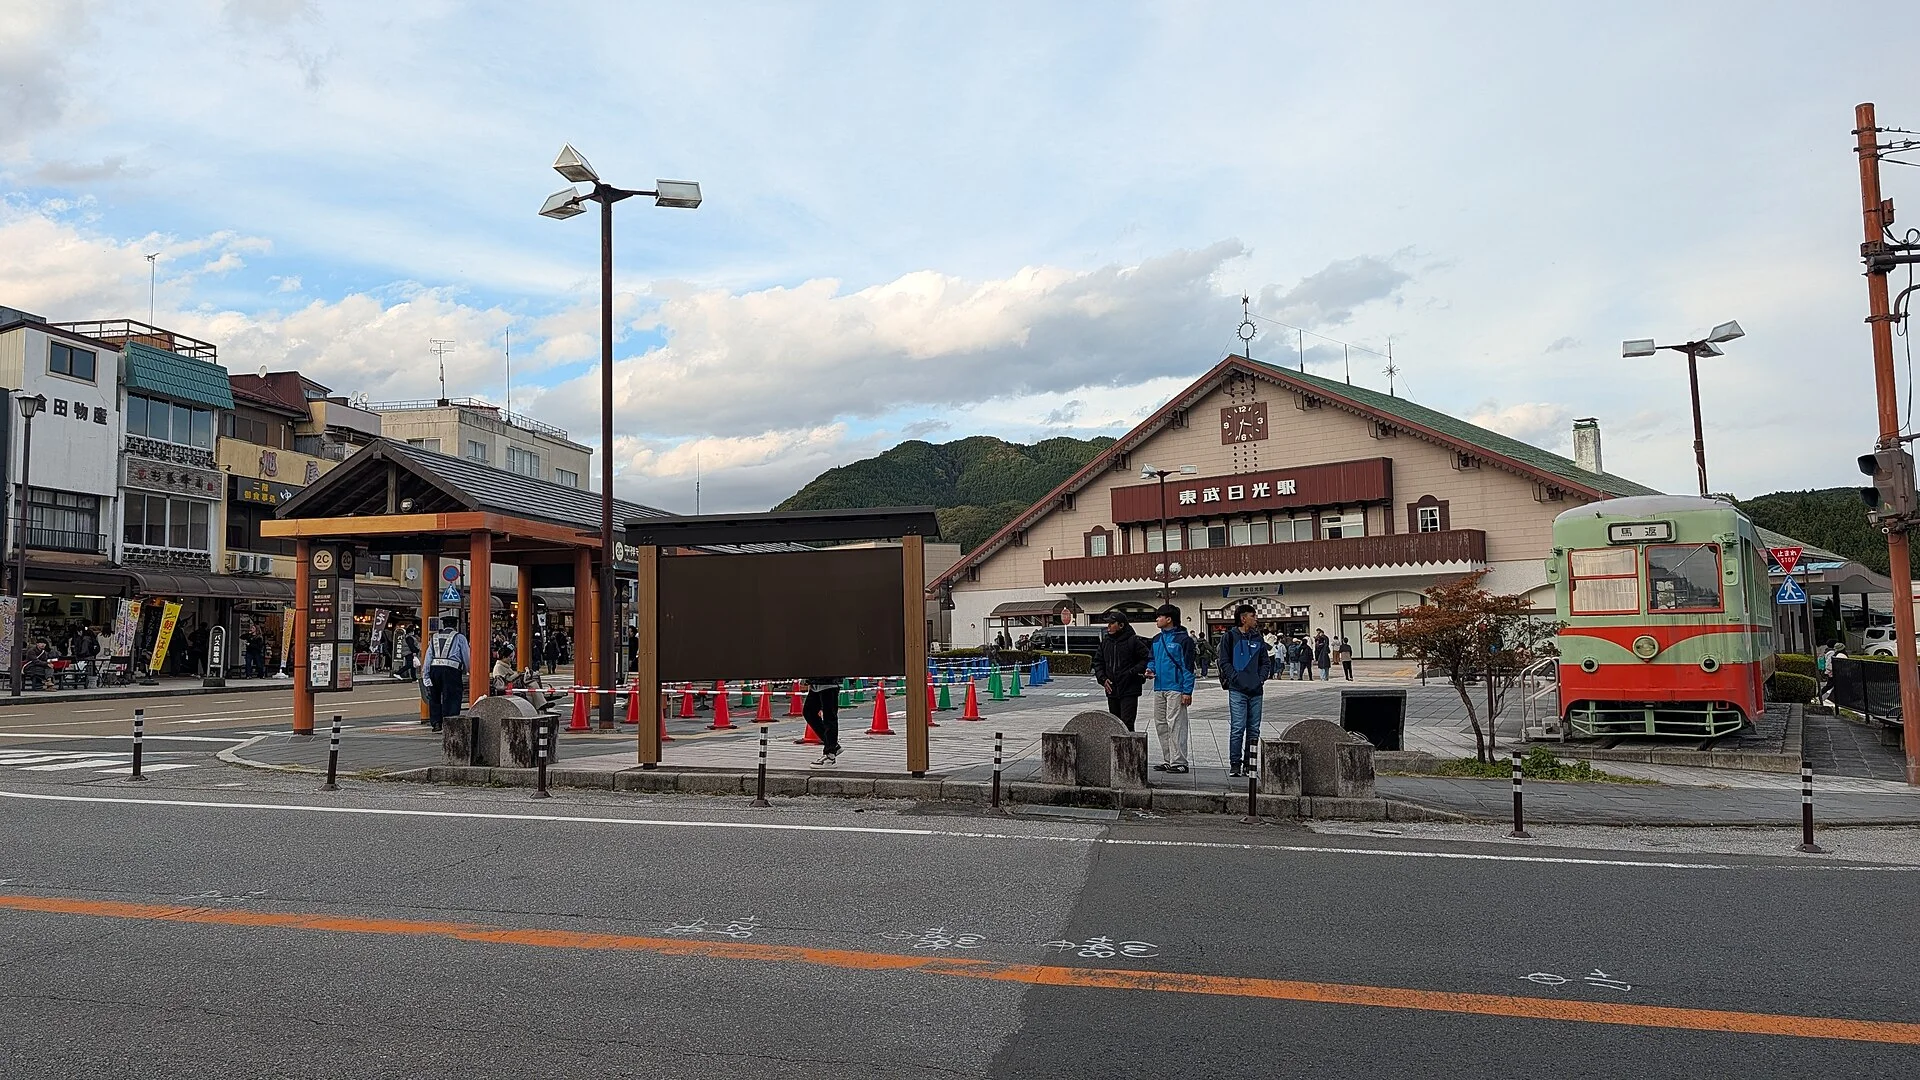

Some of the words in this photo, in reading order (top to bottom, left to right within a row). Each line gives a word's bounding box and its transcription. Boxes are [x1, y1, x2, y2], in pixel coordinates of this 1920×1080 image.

[1238, 405, 1247, 413] 12
[1256, 417, 1264, 425] 3
[1223, 421, 1230, 430] 9
[1240, 433, 1247, 441] 6
[1179, 479, 1296, 505] 東武日光駅
[1620, 526, 1657, 537] 馬返
[1777, 549, 1797, 557] 止まれ
[316, 554, 330, 564] 2C
